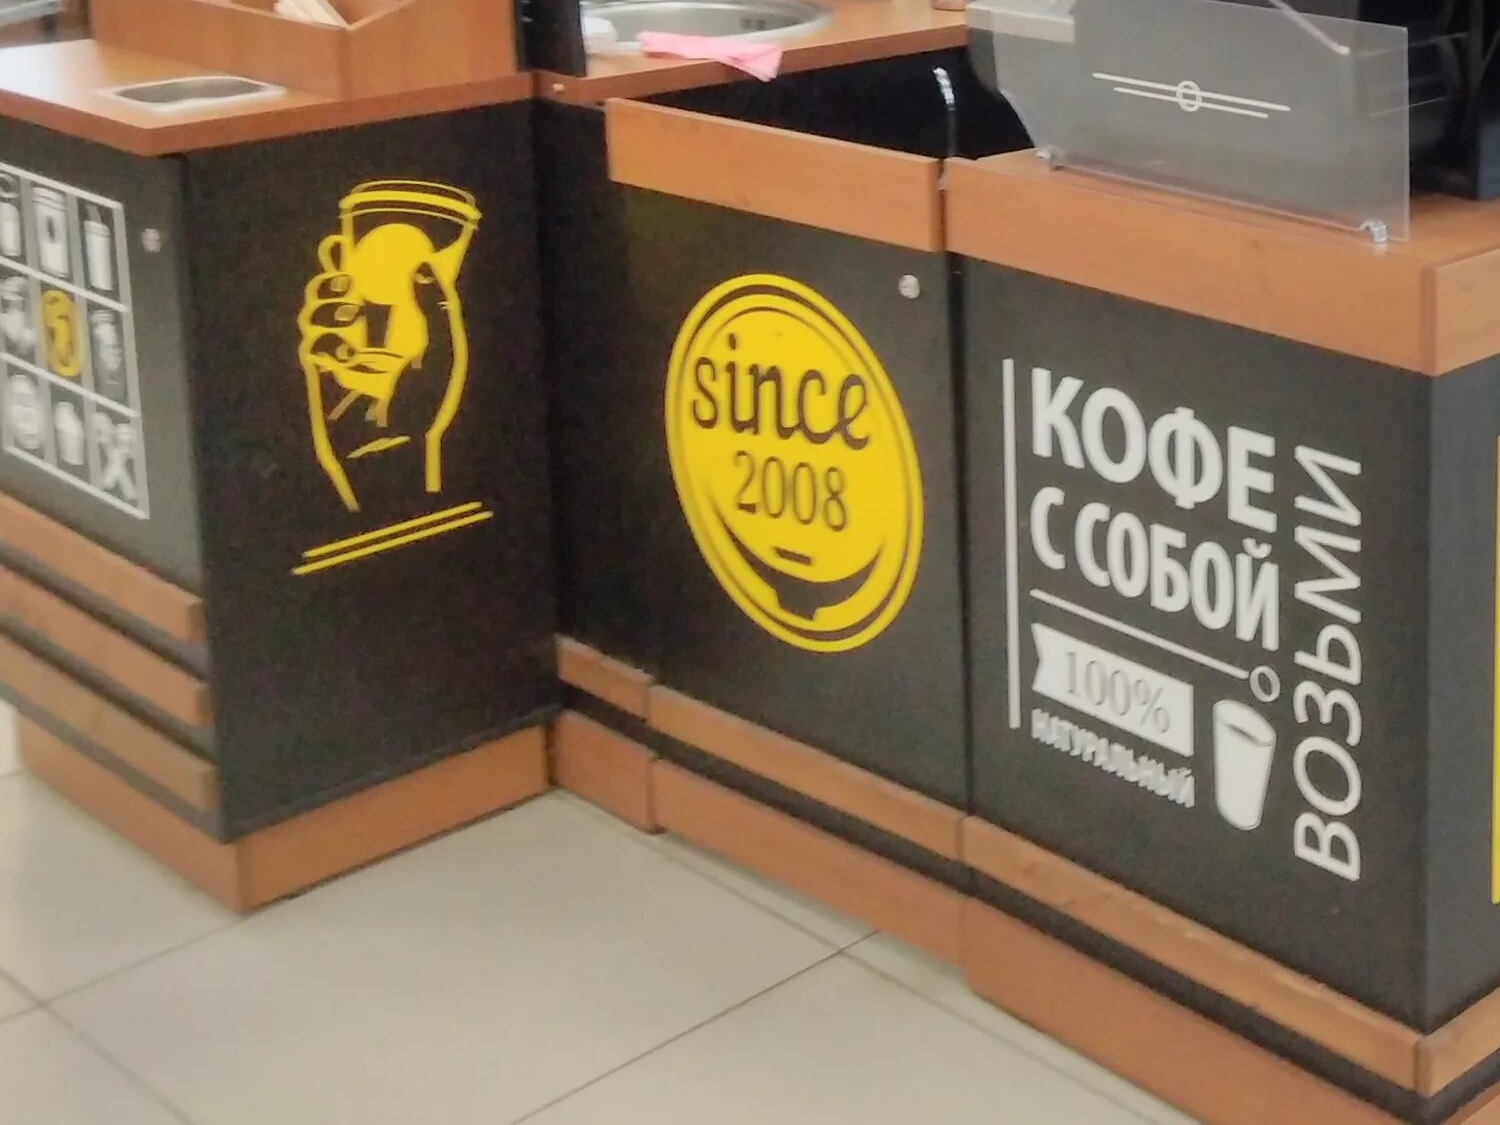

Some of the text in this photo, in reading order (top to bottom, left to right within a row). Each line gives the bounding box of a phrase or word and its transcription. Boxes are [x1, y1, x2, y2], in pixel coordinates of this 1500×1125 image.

[692, 333, 869, 450] since
[1031, 367, 1277, 533] КОФЕ
[733, 450, 847, 532] 2008
[1031, 487, 1280, 651] С СОБОЙ
[1066, 651, 1171, 734] 100%
[1295, 446, 1361, 881] ВОЗЬМИ
